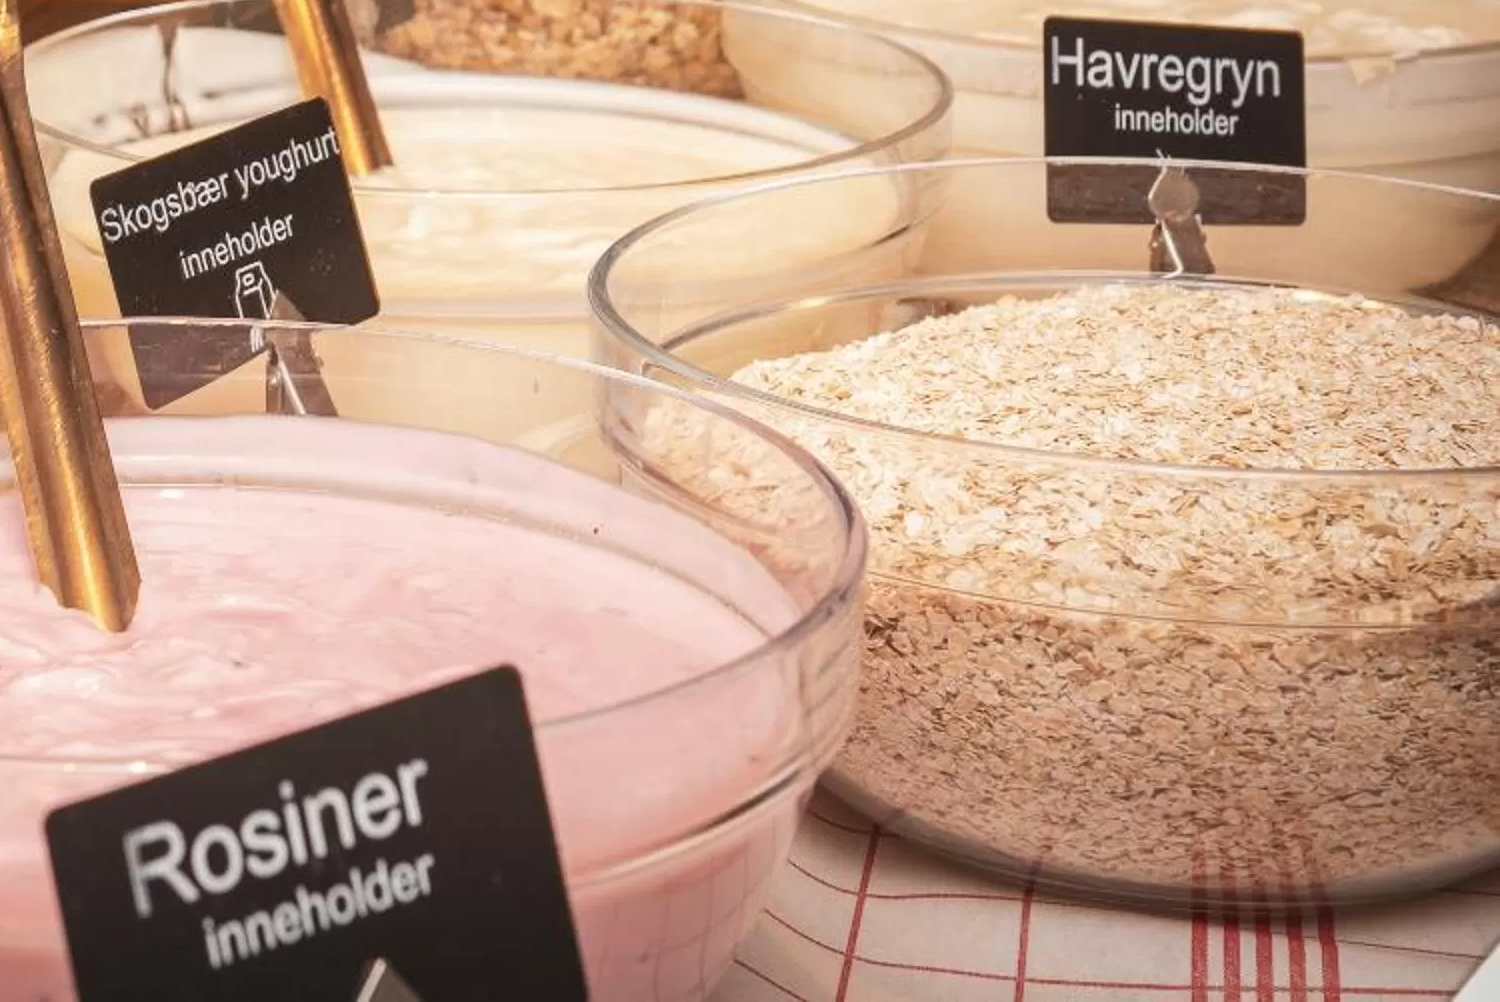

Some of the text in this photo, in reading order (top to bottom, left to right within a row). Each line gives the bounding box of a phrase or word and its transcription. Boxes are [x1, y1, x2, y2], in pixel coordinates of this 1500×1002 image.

[1051, 35, 1281, 109] Havregryn
[1114, 102, 1239, 136] inneholder
[100, 127, 341, 243] Skogsbær youghurt
[179, 213, 295, 279] inneholder
[122, 758, 429, 919] Rosiner
[200, 852, 436, 970] inneholder
